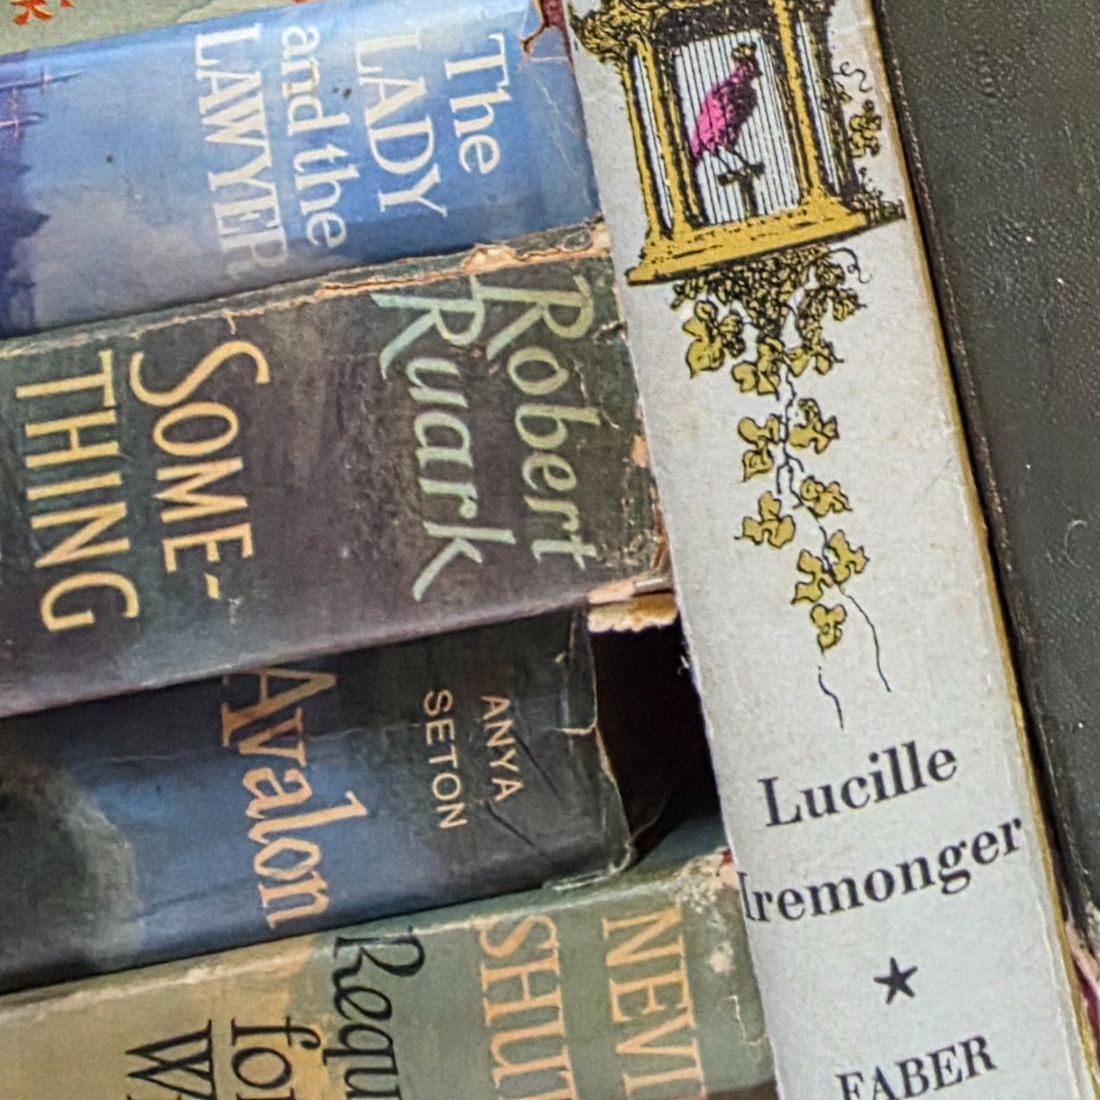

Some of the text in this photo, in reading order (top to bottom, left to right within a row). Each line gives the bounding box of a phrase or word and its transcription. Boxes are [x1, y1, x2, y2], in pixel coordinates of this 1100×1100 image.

[194, 22, 288, 281] LAWYER
[280, 24, 360, 250] and the
[355, 26, 448, 218] LADY
[444, 32, 512, 175] The
[15, 350, 140, 633] THING
[128, 340, 270, 600] SOME-
[370, 292, 516, 602] Ruark
[469, 274, 601, 571] Robert
[220, 666, 367, 930] Avalon
[423, 689, 468, 829] SETON
[481, 695, 524, 802] ANYA
[757, 741, 957, 826] Lucille
[737, 818, 1022, 922] Iremonger
[230, 1016, 321, 1100] fo
[602, 900, 707, 1100] NEVI
[835, 1035, 997, 1100] FABER
